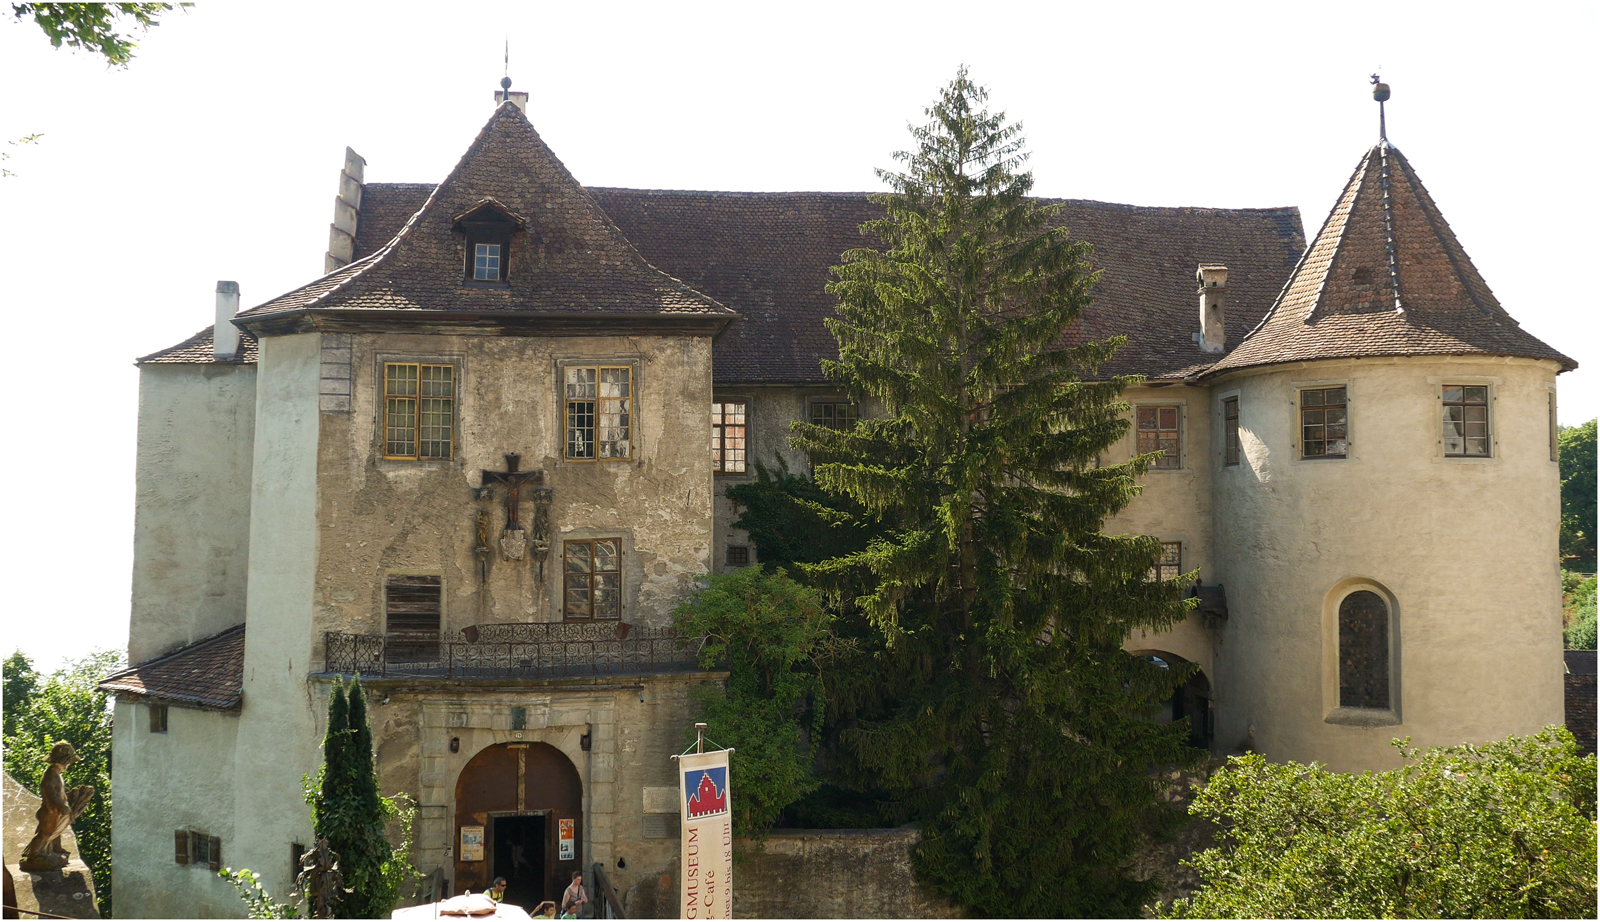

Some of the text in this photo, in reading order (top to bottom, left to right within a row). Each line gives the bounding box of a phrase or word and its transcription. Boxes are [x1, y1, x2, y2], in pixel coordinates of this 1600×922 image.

[724, 850, 731, 862] 18
[686, 828, 698, 920] GMUSEUM
[724, 888, 730, 896] 9
